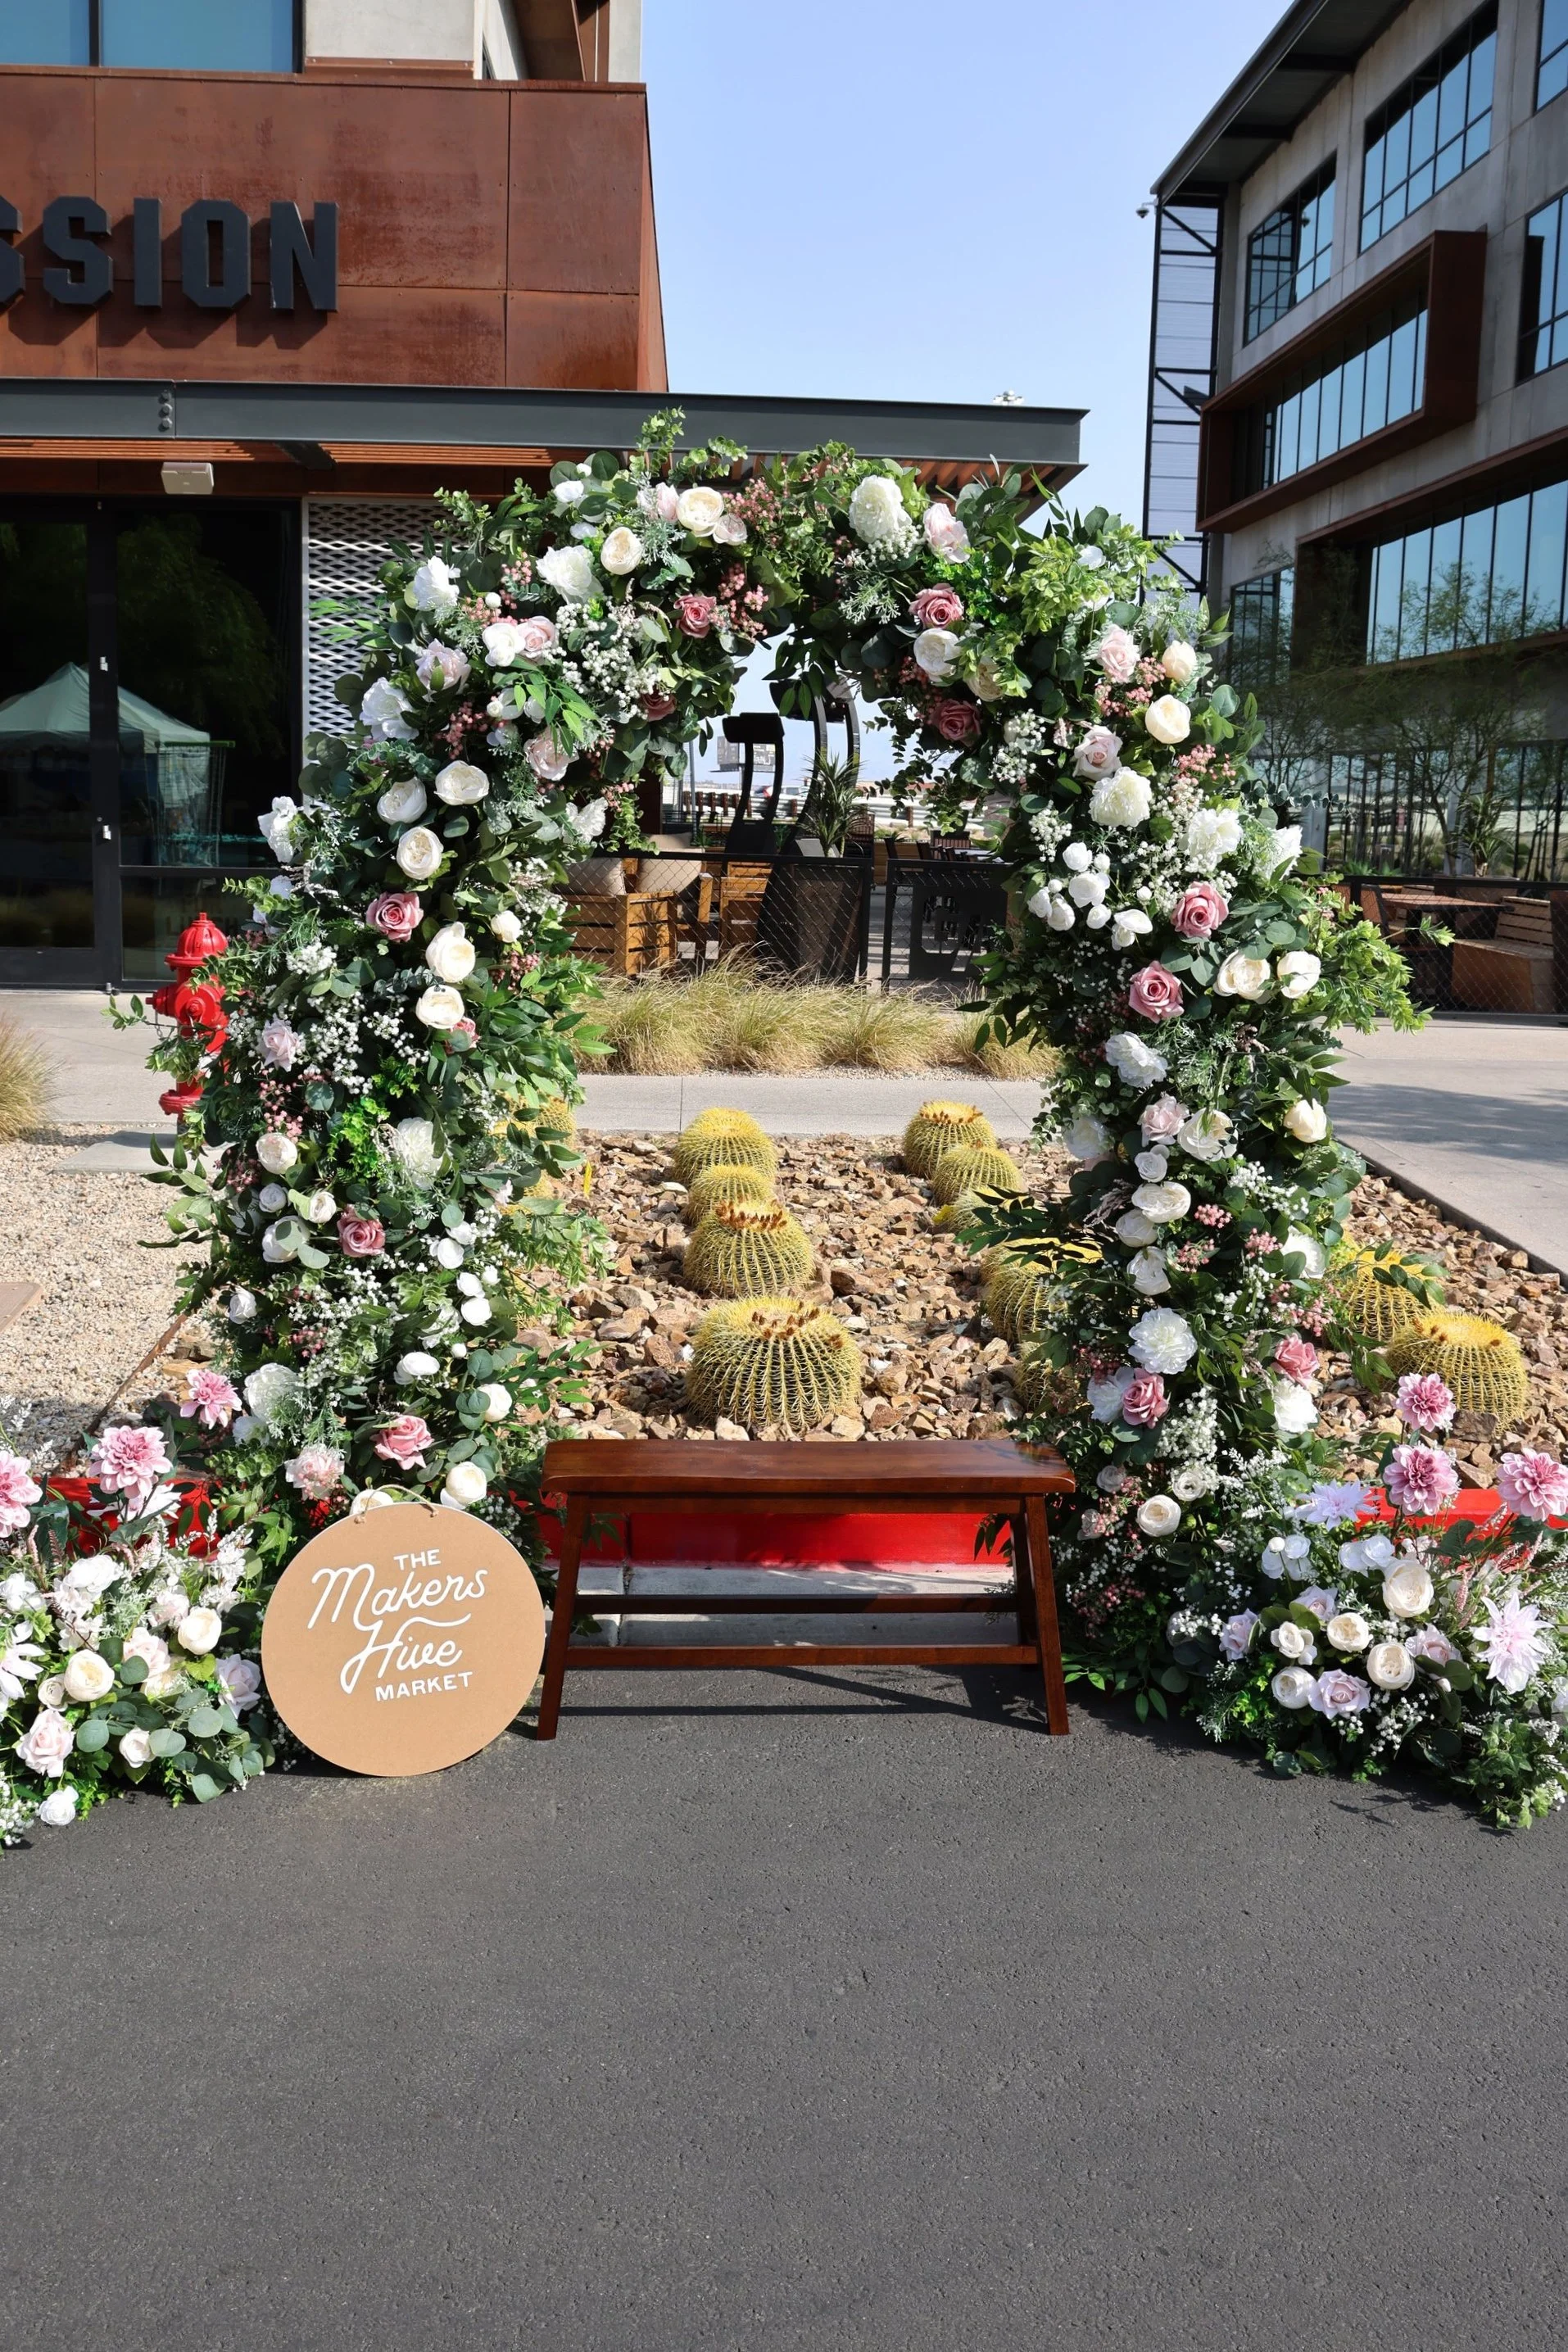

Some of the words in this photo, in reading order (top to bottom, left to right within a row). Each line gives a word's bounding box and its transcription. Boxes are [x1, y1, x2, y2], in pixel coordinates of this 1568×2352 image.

[393, 1548, 442, 1570] THE
[307, 1563, 488, 1630] Makers
[340, 1613, 472, 1694] Hive
[375, 1671, 474, 1702] MARKET
